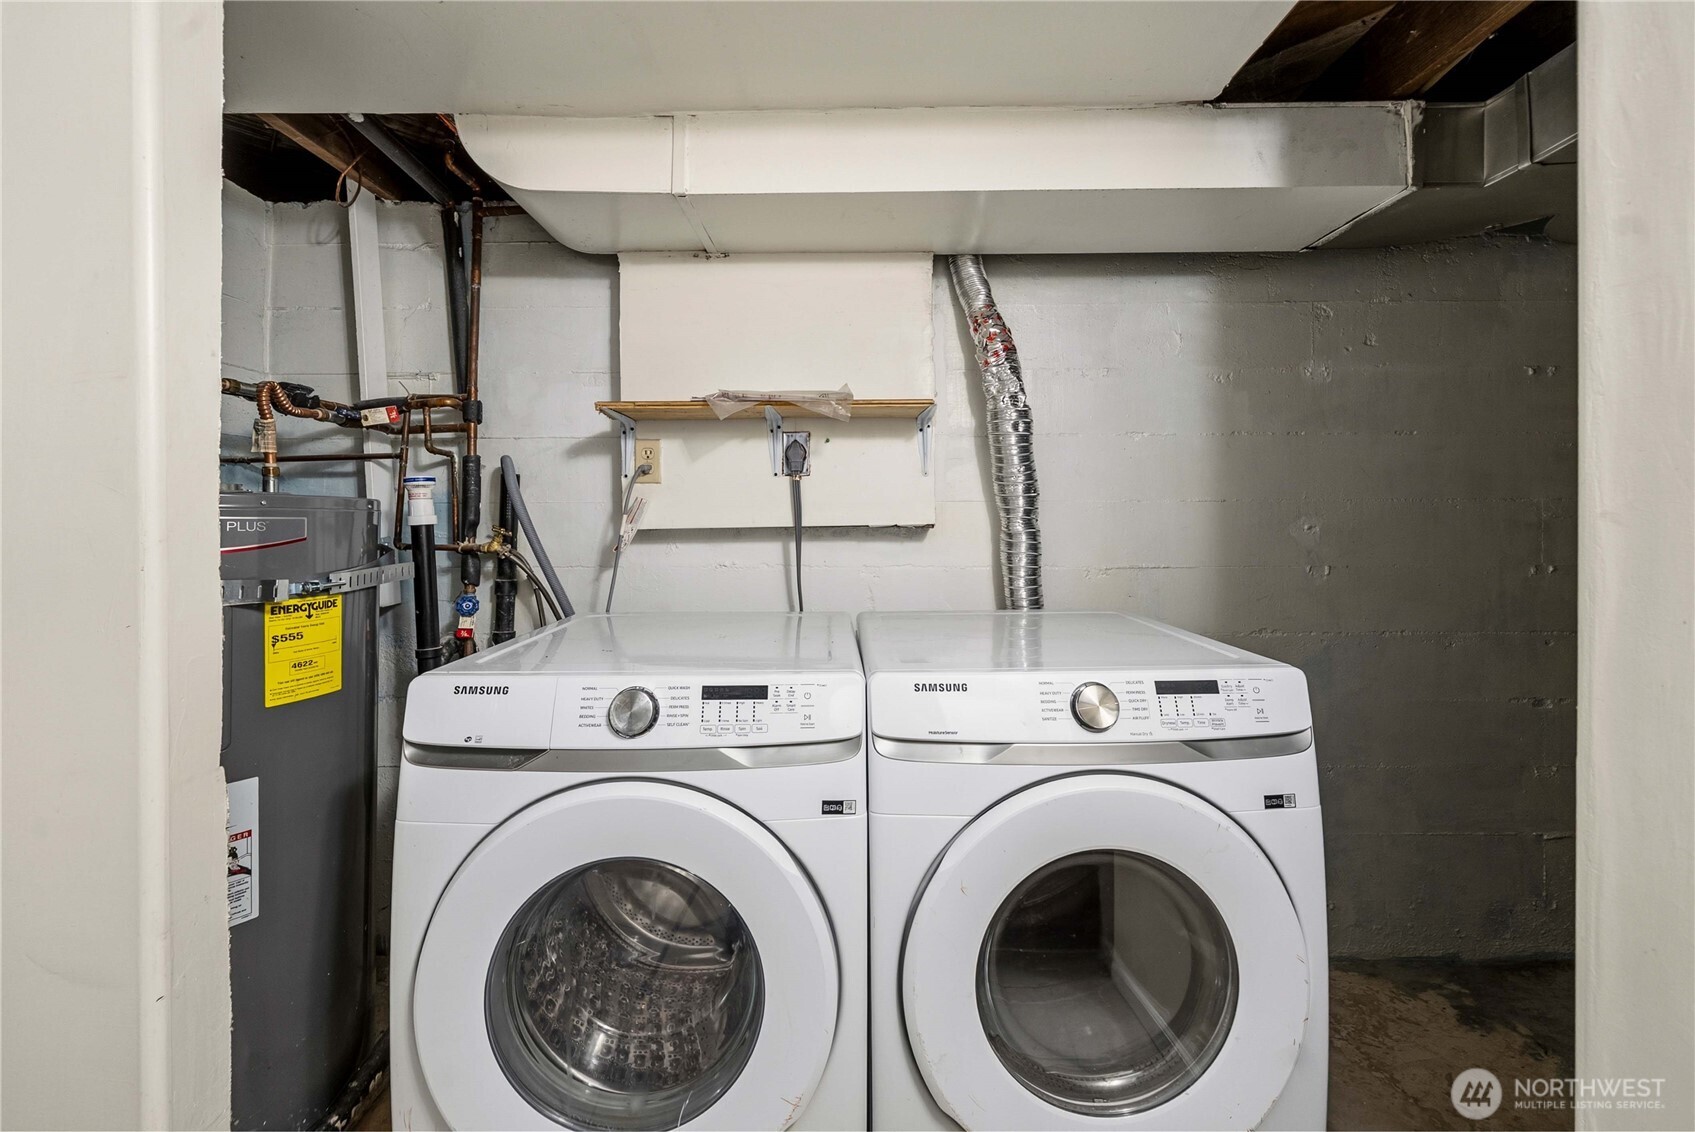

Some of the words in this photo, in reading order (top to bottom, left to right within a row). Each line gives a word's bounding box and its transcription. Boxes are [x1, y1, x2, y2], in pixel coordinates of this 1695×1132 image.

[226, 521, 267, 532] PLUS
[270, 599, 338, 616] ENERGYGUIDE
[272, 632, 304, 644] $555
[292, 660, 314, 669] 4622
[454, 686, 510, 695] SAMSUNG
[914, 682, 968, 692] SAMSUNG
